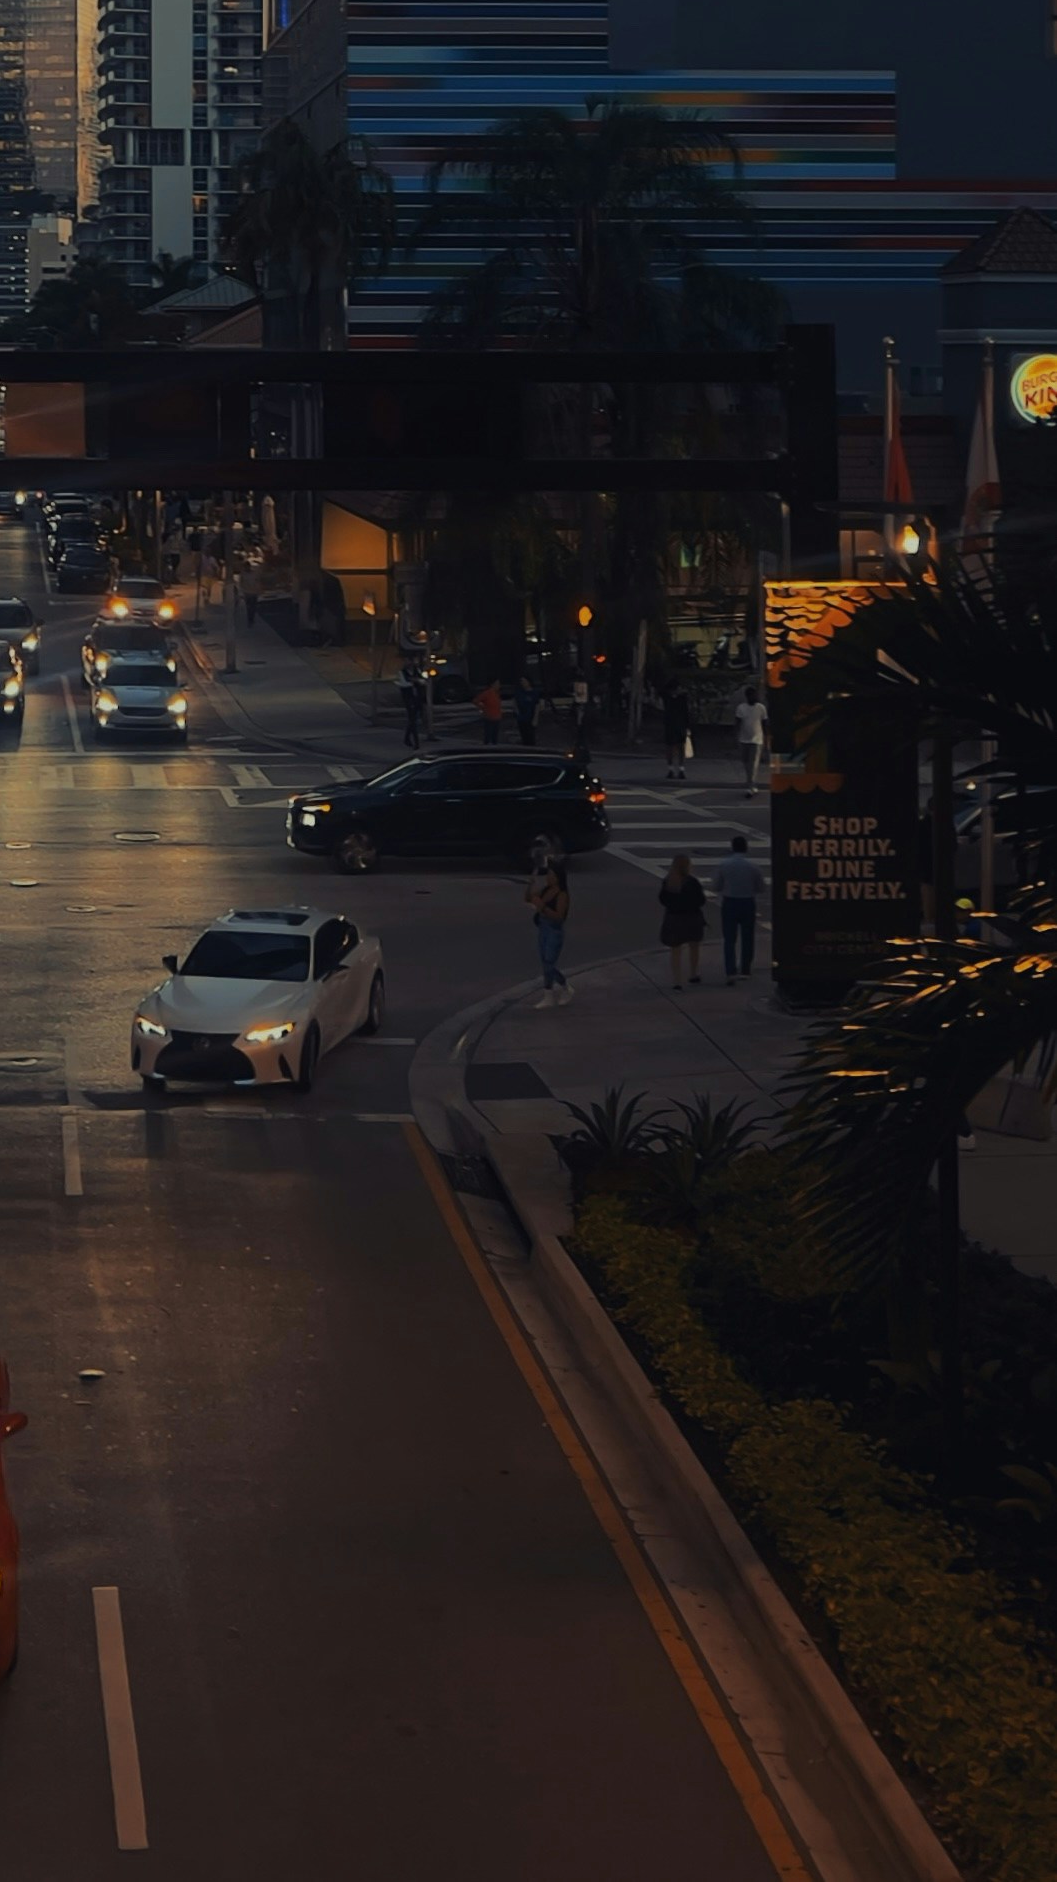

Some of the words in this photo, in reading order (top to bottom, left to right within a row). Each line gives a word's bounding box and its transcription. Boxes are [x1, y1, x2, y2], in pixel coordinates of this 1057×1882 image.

[813, 815, 878, 835] SHOP
[788, 839, 896, 857] MERRILY.
[817, 858, 876, 878] DINE
[785, 880, 907, 900] FESTIVELY.
